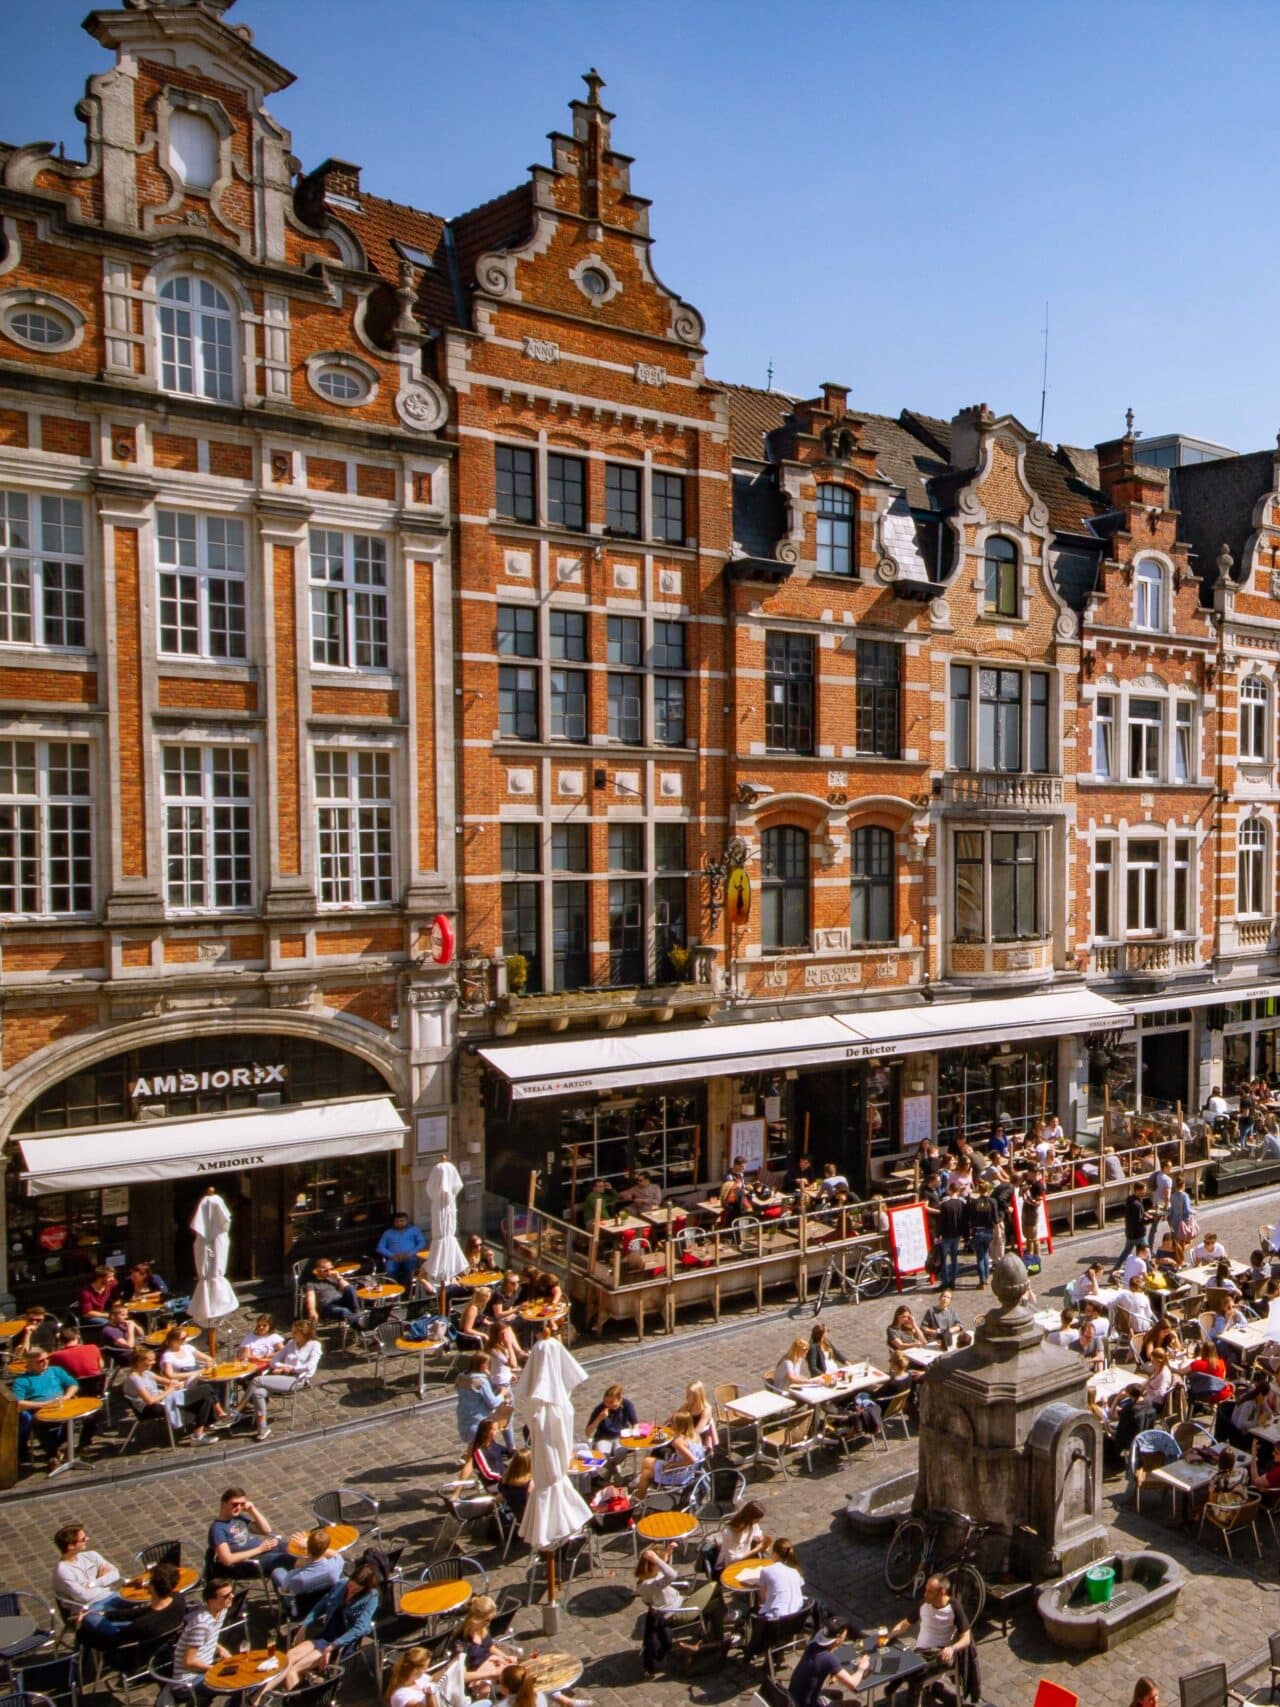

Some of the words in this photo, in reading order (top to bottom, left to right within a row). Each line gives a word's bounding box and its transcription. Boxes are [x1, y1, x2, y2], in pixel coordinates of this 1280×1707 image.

[845, 1048, 860, 1057] De
[862, 1045, 897, 1056] Rector
[132, 1064, 285, 1098] AMBIORIX
[523, 1084, 553, 1094] STELLA
[562, 1080, 593, 1089] ARTOIS
[197, 1155, 265, 1172] AMBIORIX
